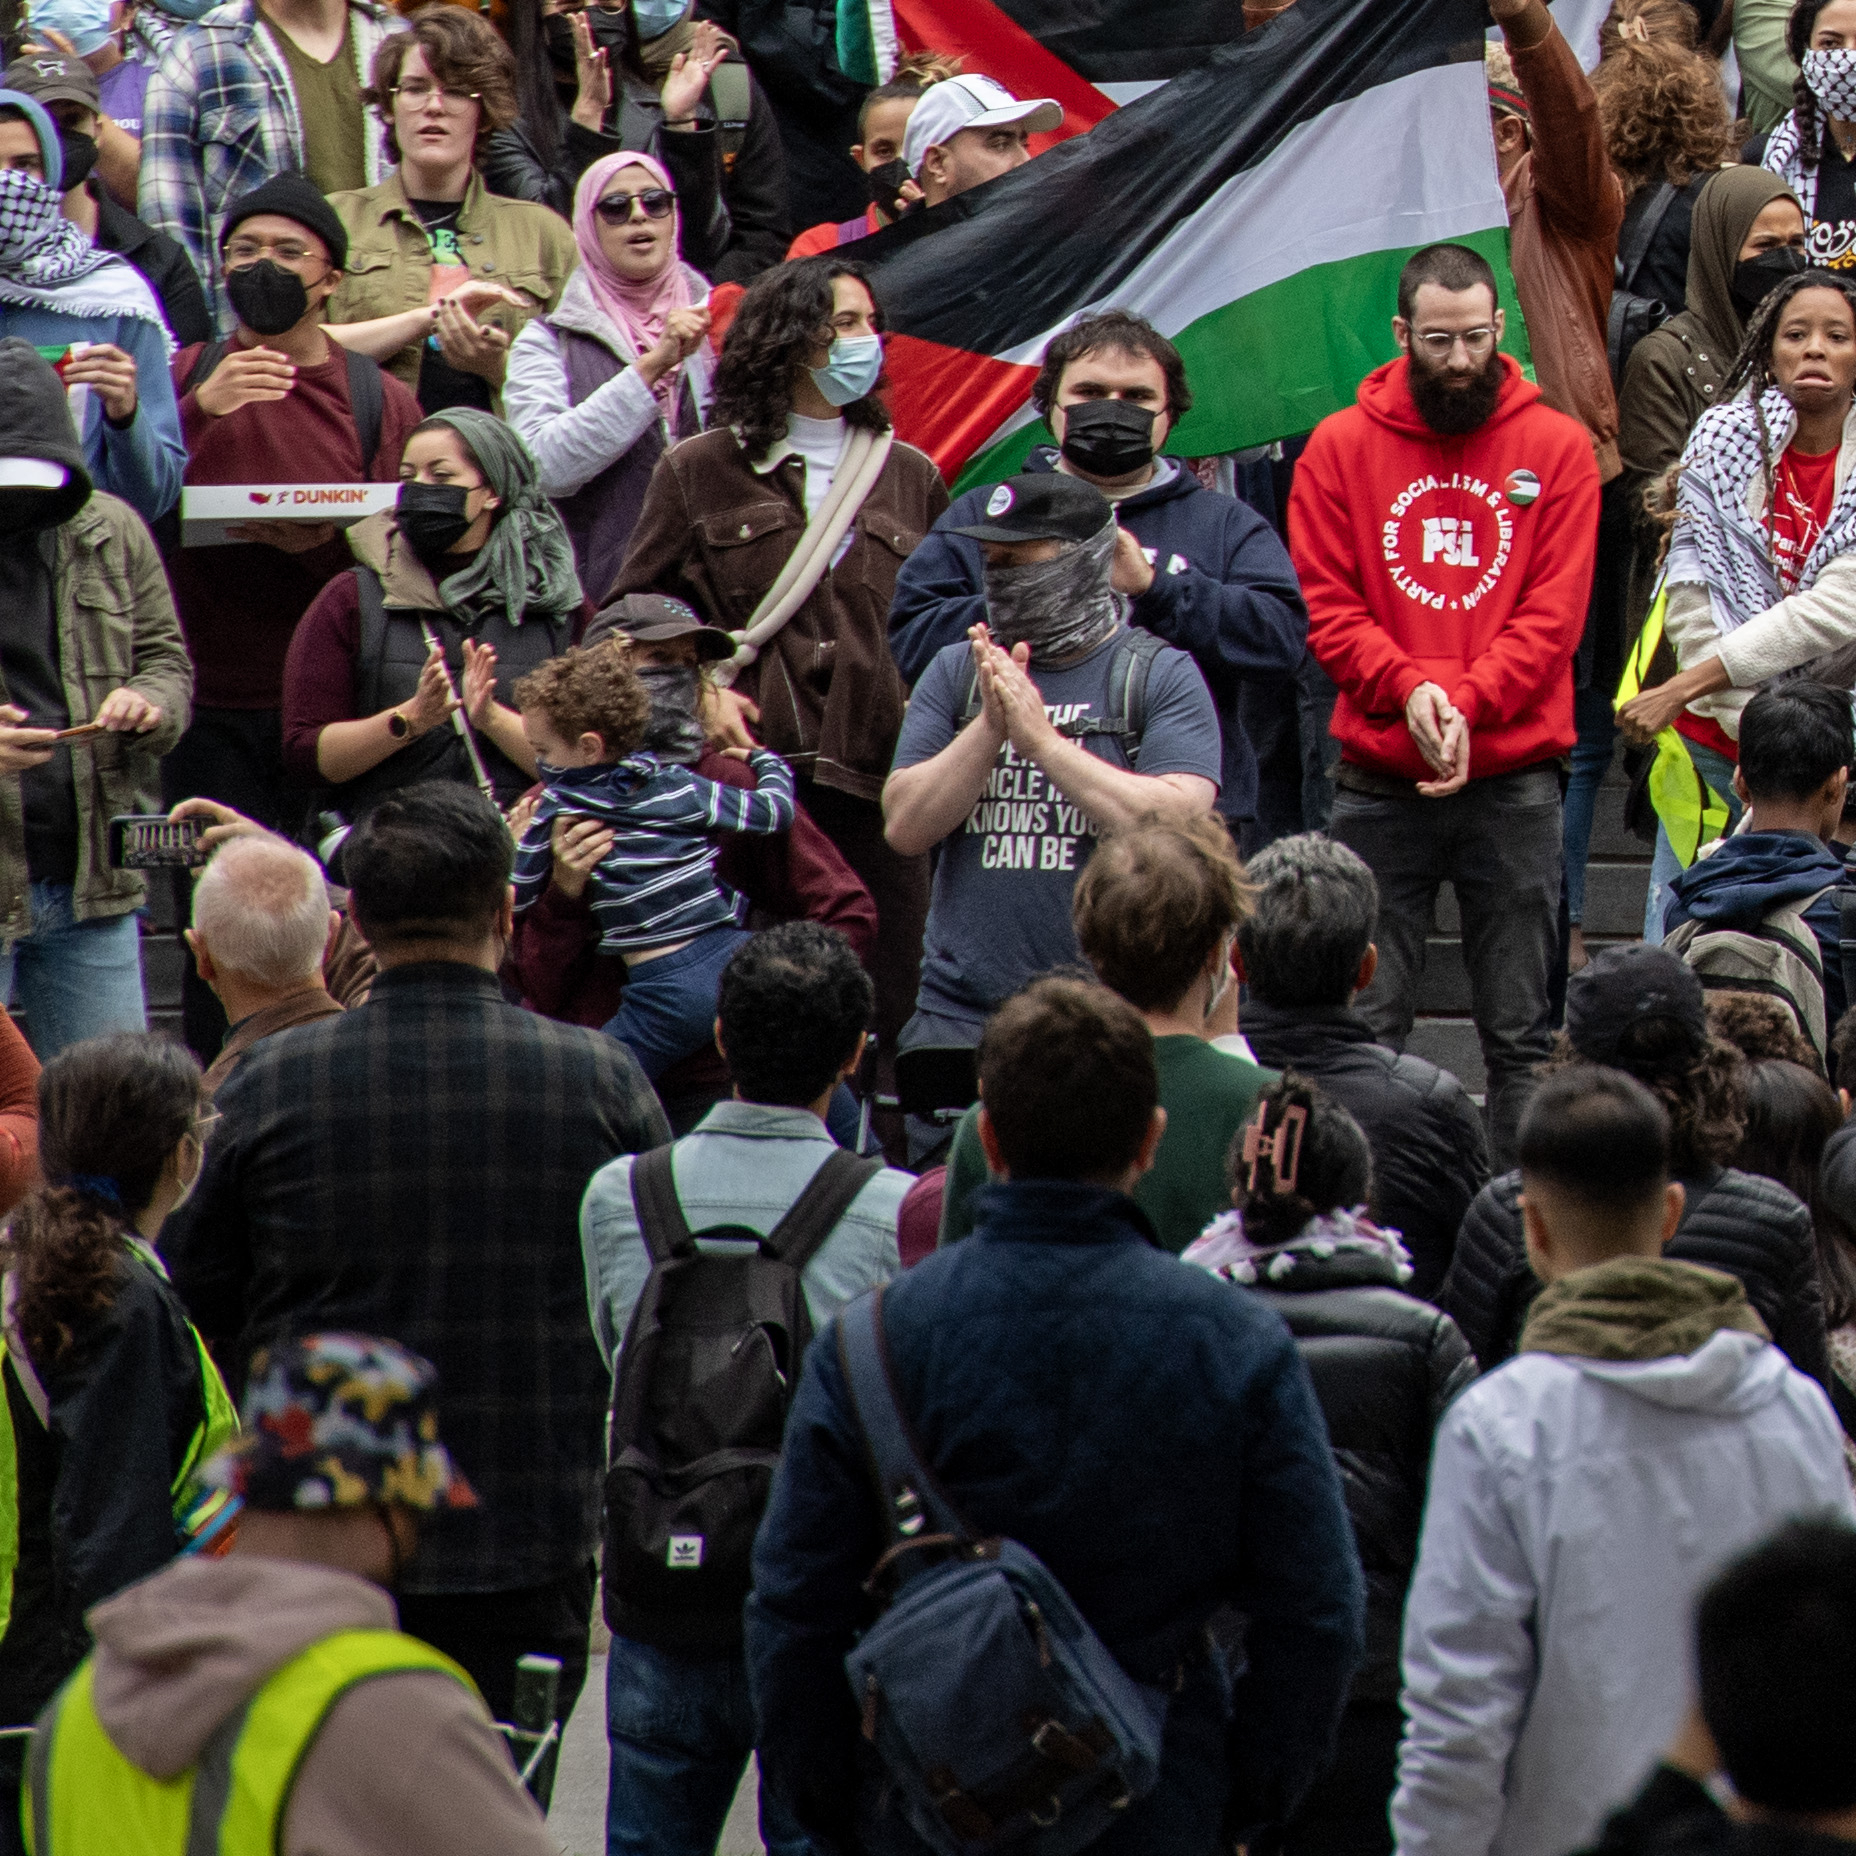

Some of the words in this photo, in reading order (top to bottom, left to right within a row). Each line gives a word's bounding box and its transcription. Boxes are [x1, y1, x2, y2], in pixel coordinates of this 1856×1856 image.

[1383, 520, 1400, 561] FOR
[1388, 565, 1446, 610] PARTY
[983, 767, 1044, 800] NCLE
[966, 801, 1049, 834] KNOWS
[982, 834, 1035, 870] CAN
[1040, 835, 1077, 871] BE
